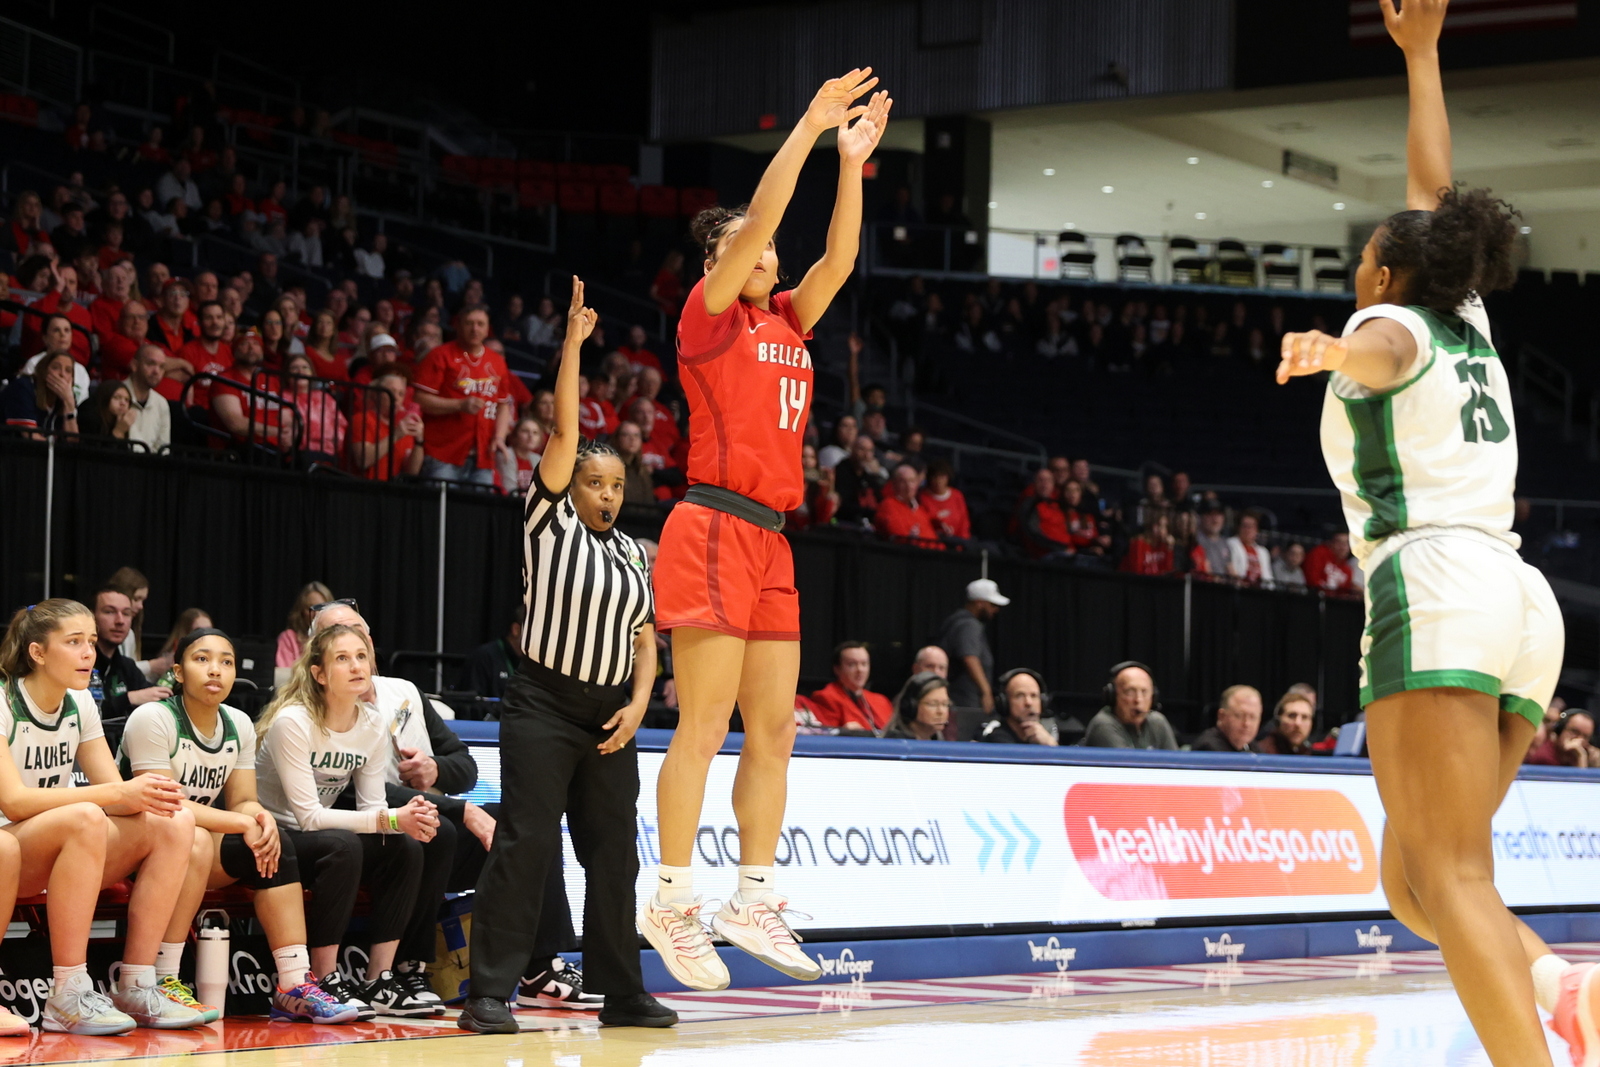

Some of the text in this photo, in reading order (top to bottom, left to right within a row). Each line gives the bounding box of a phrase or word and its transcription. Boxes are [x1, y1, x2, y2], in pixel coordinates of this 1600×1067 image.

[778, 376, 807, 432] 14
[24, 741, 73, 770] LAUREL
[179, 762, 227, 789] LAUREL
[697, 824, 817, 867] acon
[824, 819, 950, 866] council
[1087, 815, 1364, 874] healthykidsgo.org
[836, 948, 874, 982] Kroger
[0, 967, 55, 1024] oger
